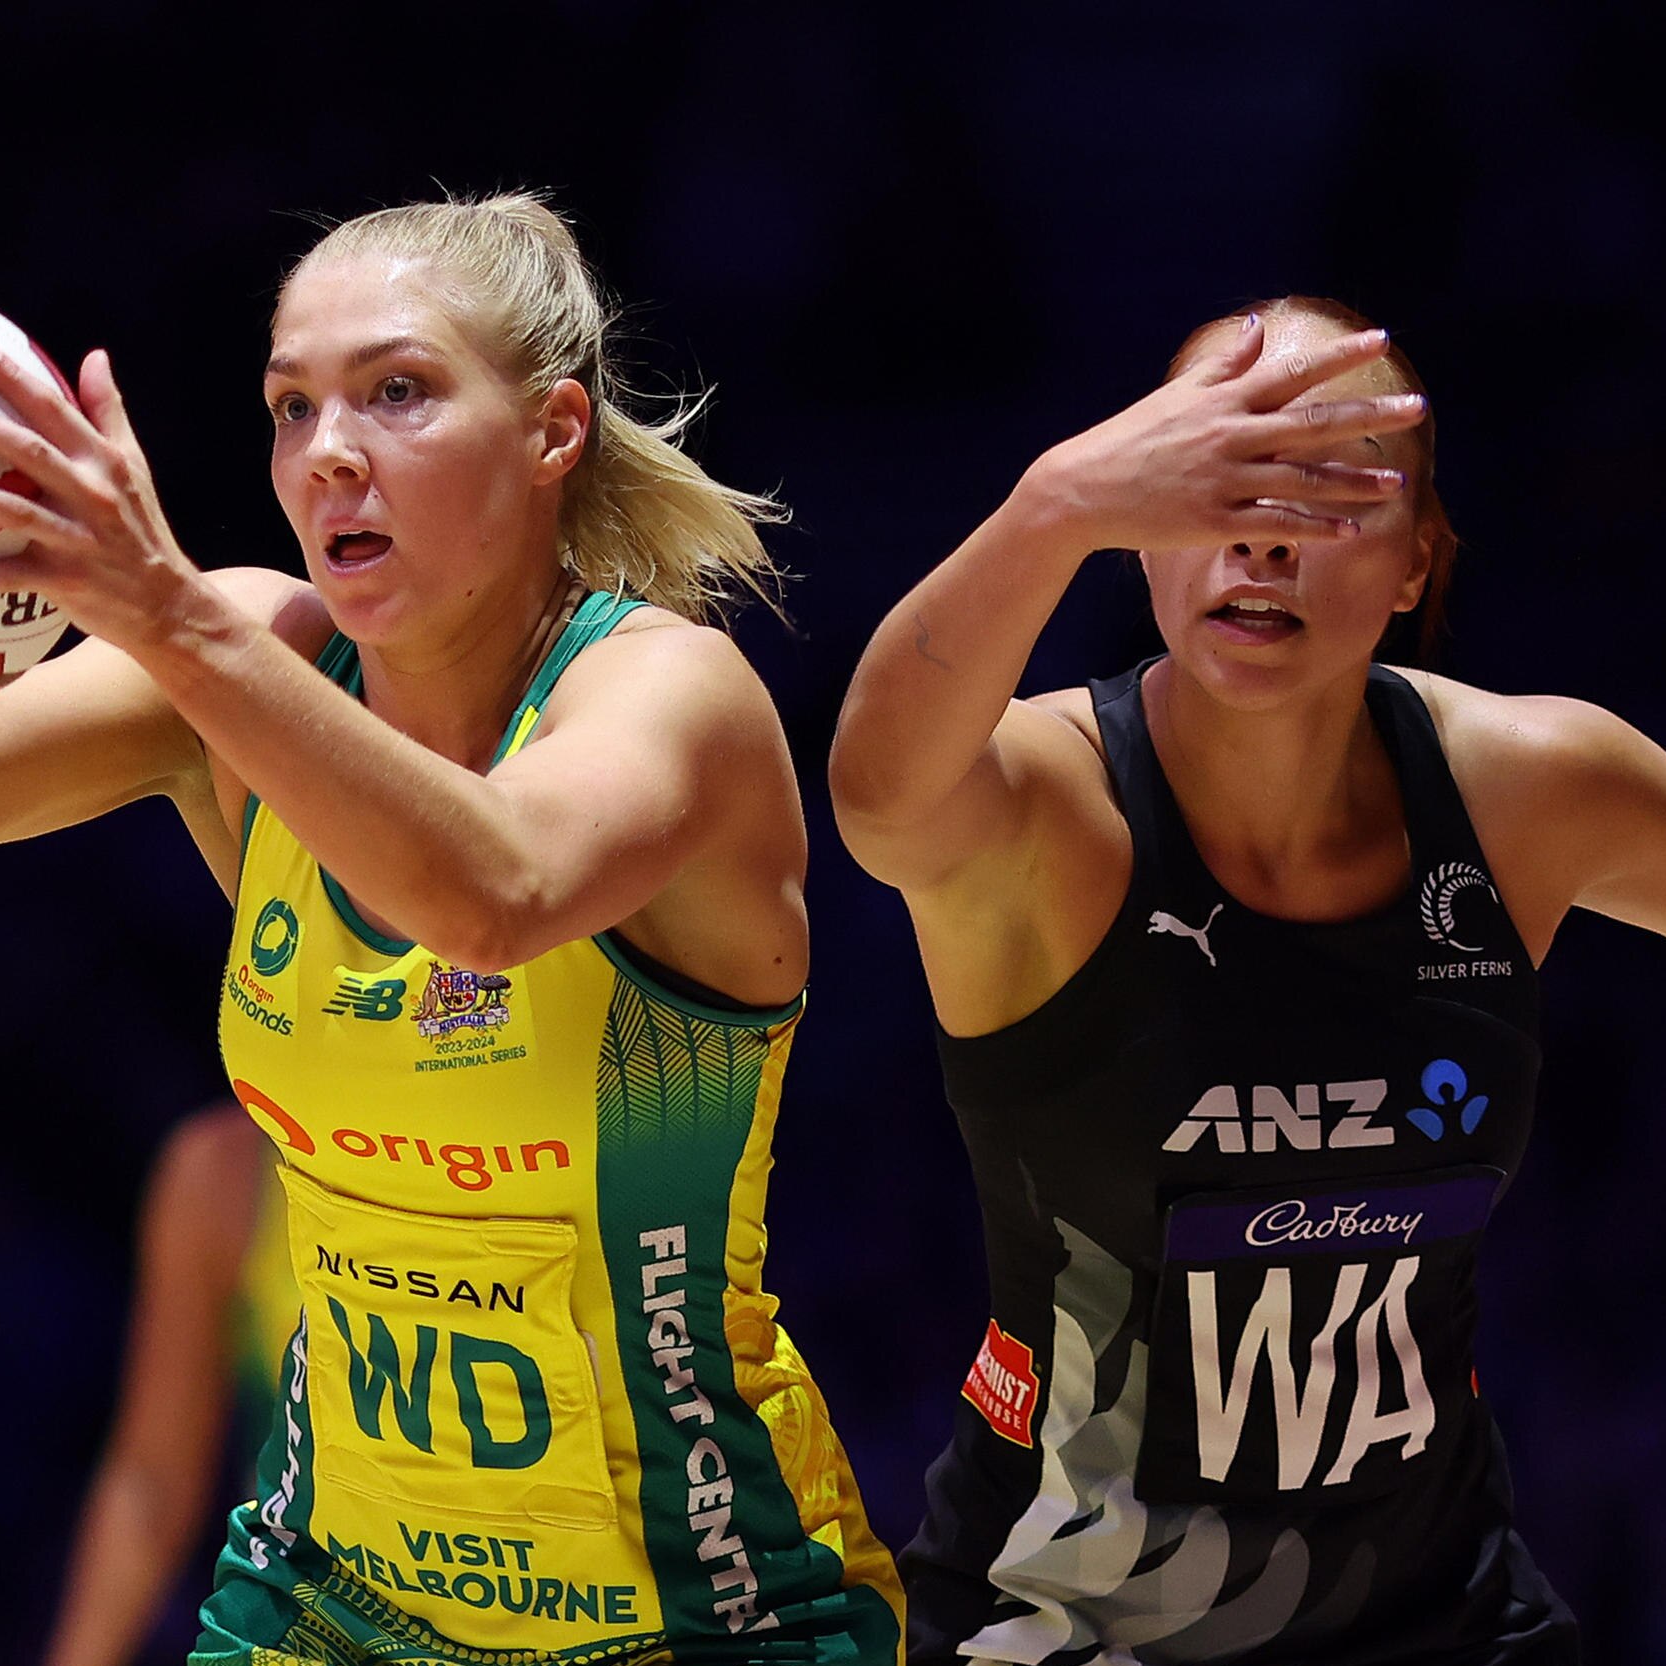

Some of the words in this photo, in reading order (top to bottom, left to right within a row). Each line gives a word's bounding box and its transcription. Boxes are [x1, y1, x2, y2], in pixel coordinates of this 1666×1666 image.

[1417, 963, 1467, 980] SILVER
[1471, 960, 1513, 978] FERNS
[415, 1054, 488, 1072] INTERNATIONAL
[490, 1045, 526, 1063] SERIES
[435, 1036, 495, 1054] 2023-2024
[1162, 1078, 1395, 1153] ANZ
[331, 1127, 571, 1191] origin
[1244, 1199, 1424, 1247] Cadbury
[316, 1243, 524, 1313] NISSAN
[638, 1224, 712, 1426] FLIGHT
[325, 1295, 552, 1470] WD
[1186, 1254, 1436, 1490] WA
[326, 1531, 638, 1624] MELBOURNE
[396, 1520, 535, 1572] VISIT
